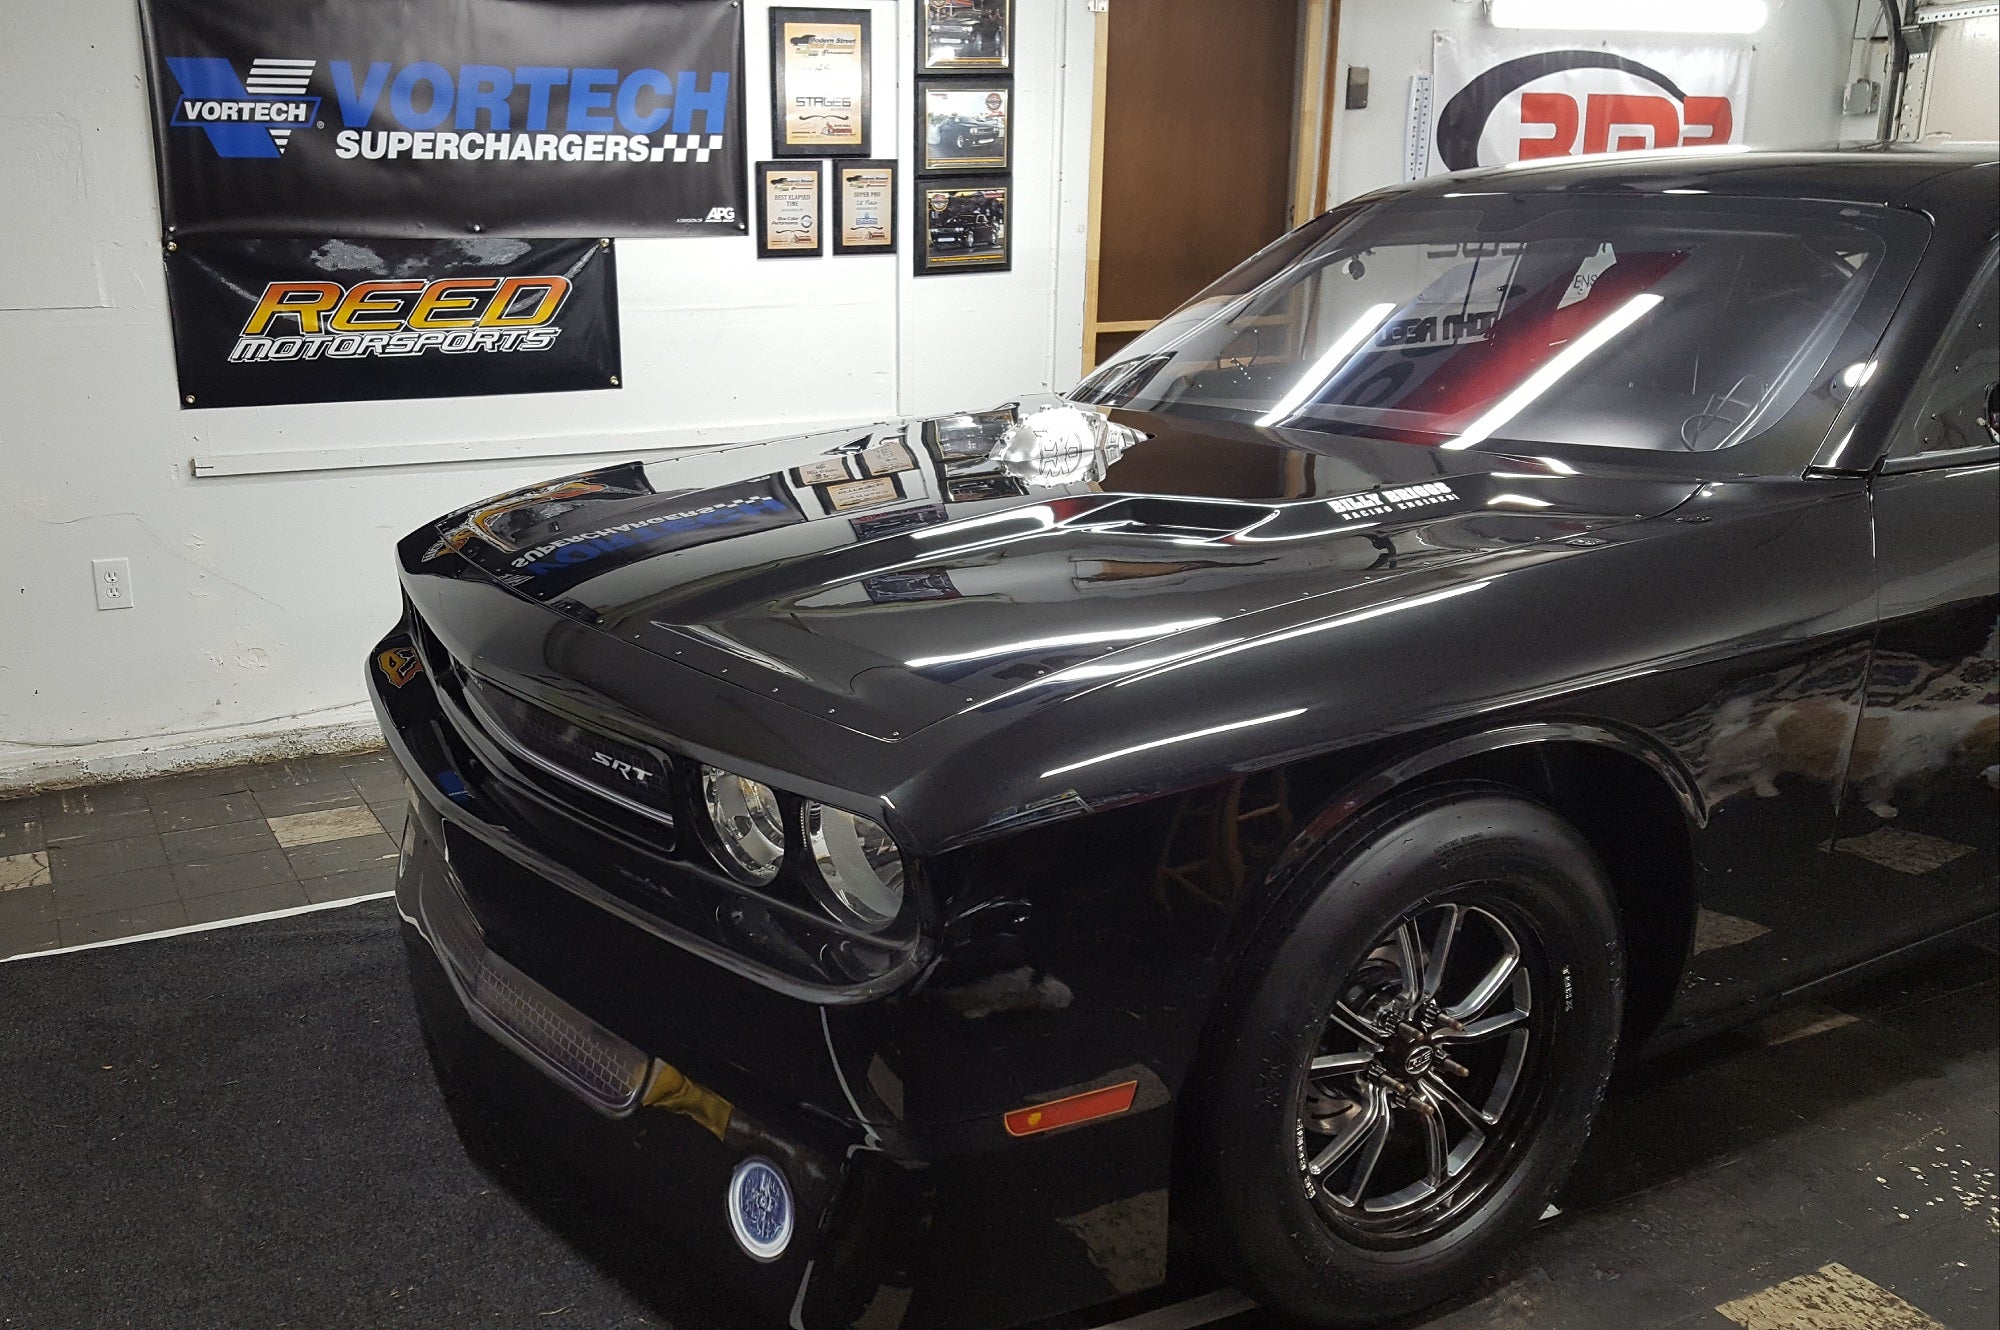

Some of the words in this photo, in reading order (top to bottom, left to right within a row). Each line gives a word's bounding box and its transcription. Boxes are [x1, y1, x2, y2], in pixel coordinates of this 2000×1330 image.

[183, 101, 307, 122] VORTECH
[329, 60, 731, 134] VORTECH
[335, 130, 650, 163] SUPERCHARGERS
[705, 207, 736, 220] APG
[239, 276, 572, 337] REED
[227, 327, 563, 363] MOTORSPORTS
[1326, 492, 1384, 514] BILLY
[1381, 481, 1452, 503] BRIGGS
[1341, 505, 1393, 521] RACING
[591, 751, 653, 781] SRT
